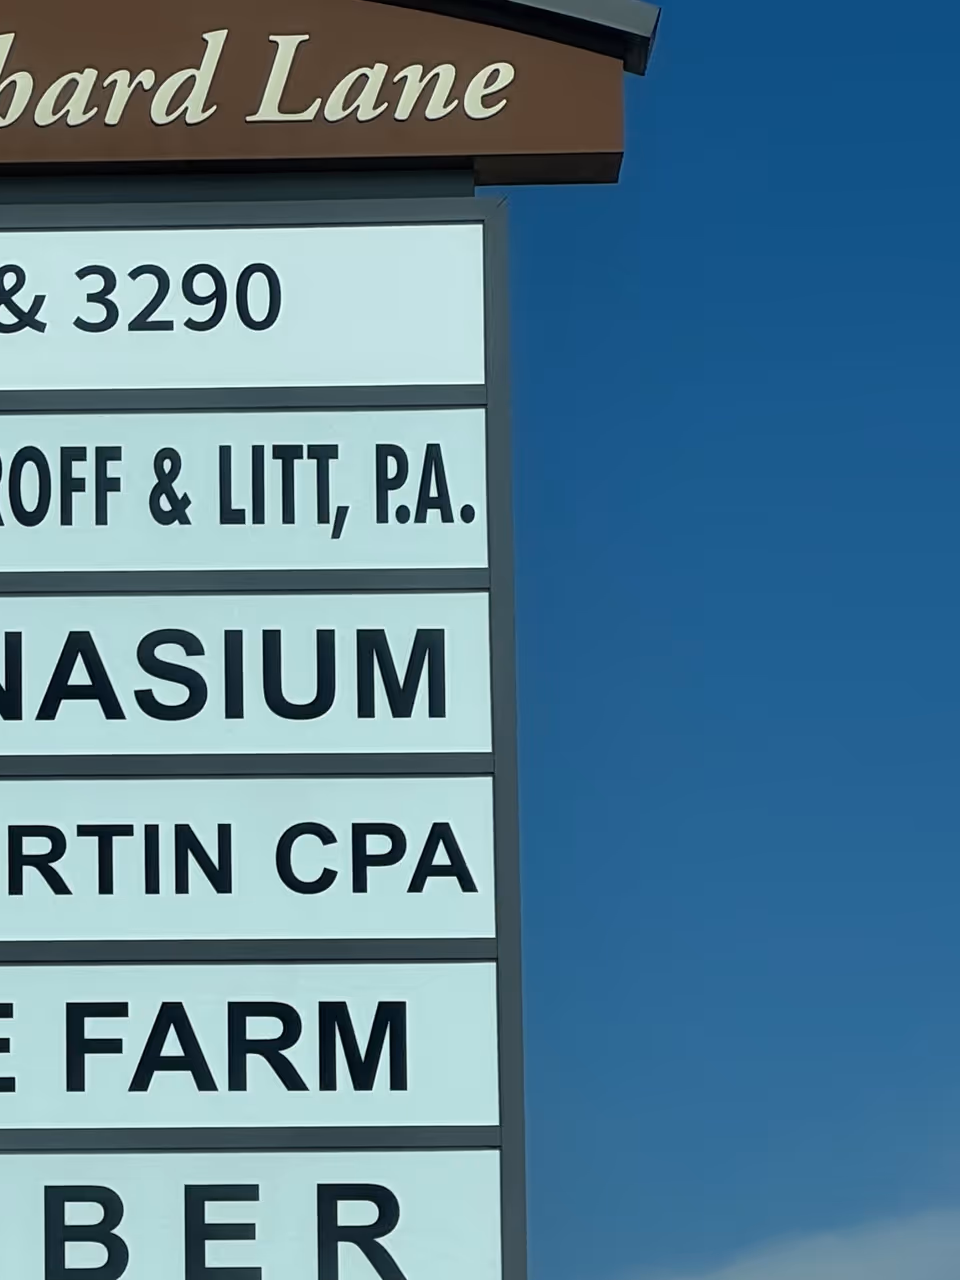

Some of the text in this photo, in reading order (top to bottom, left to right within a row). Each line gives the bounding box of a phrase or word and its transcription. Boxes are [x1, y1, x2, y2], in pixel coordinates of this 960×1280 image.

[245, 34, 515, 122] Lane
[72, 262, 282, 333] 3290
[148, 445, 193, 526] &
[218, 443, 350, 540] LITT,
[375, 443, 476, 525] P.A.
[275, 821, 479, 895] CPA
[65, 1000, 408, 1094] FARM
